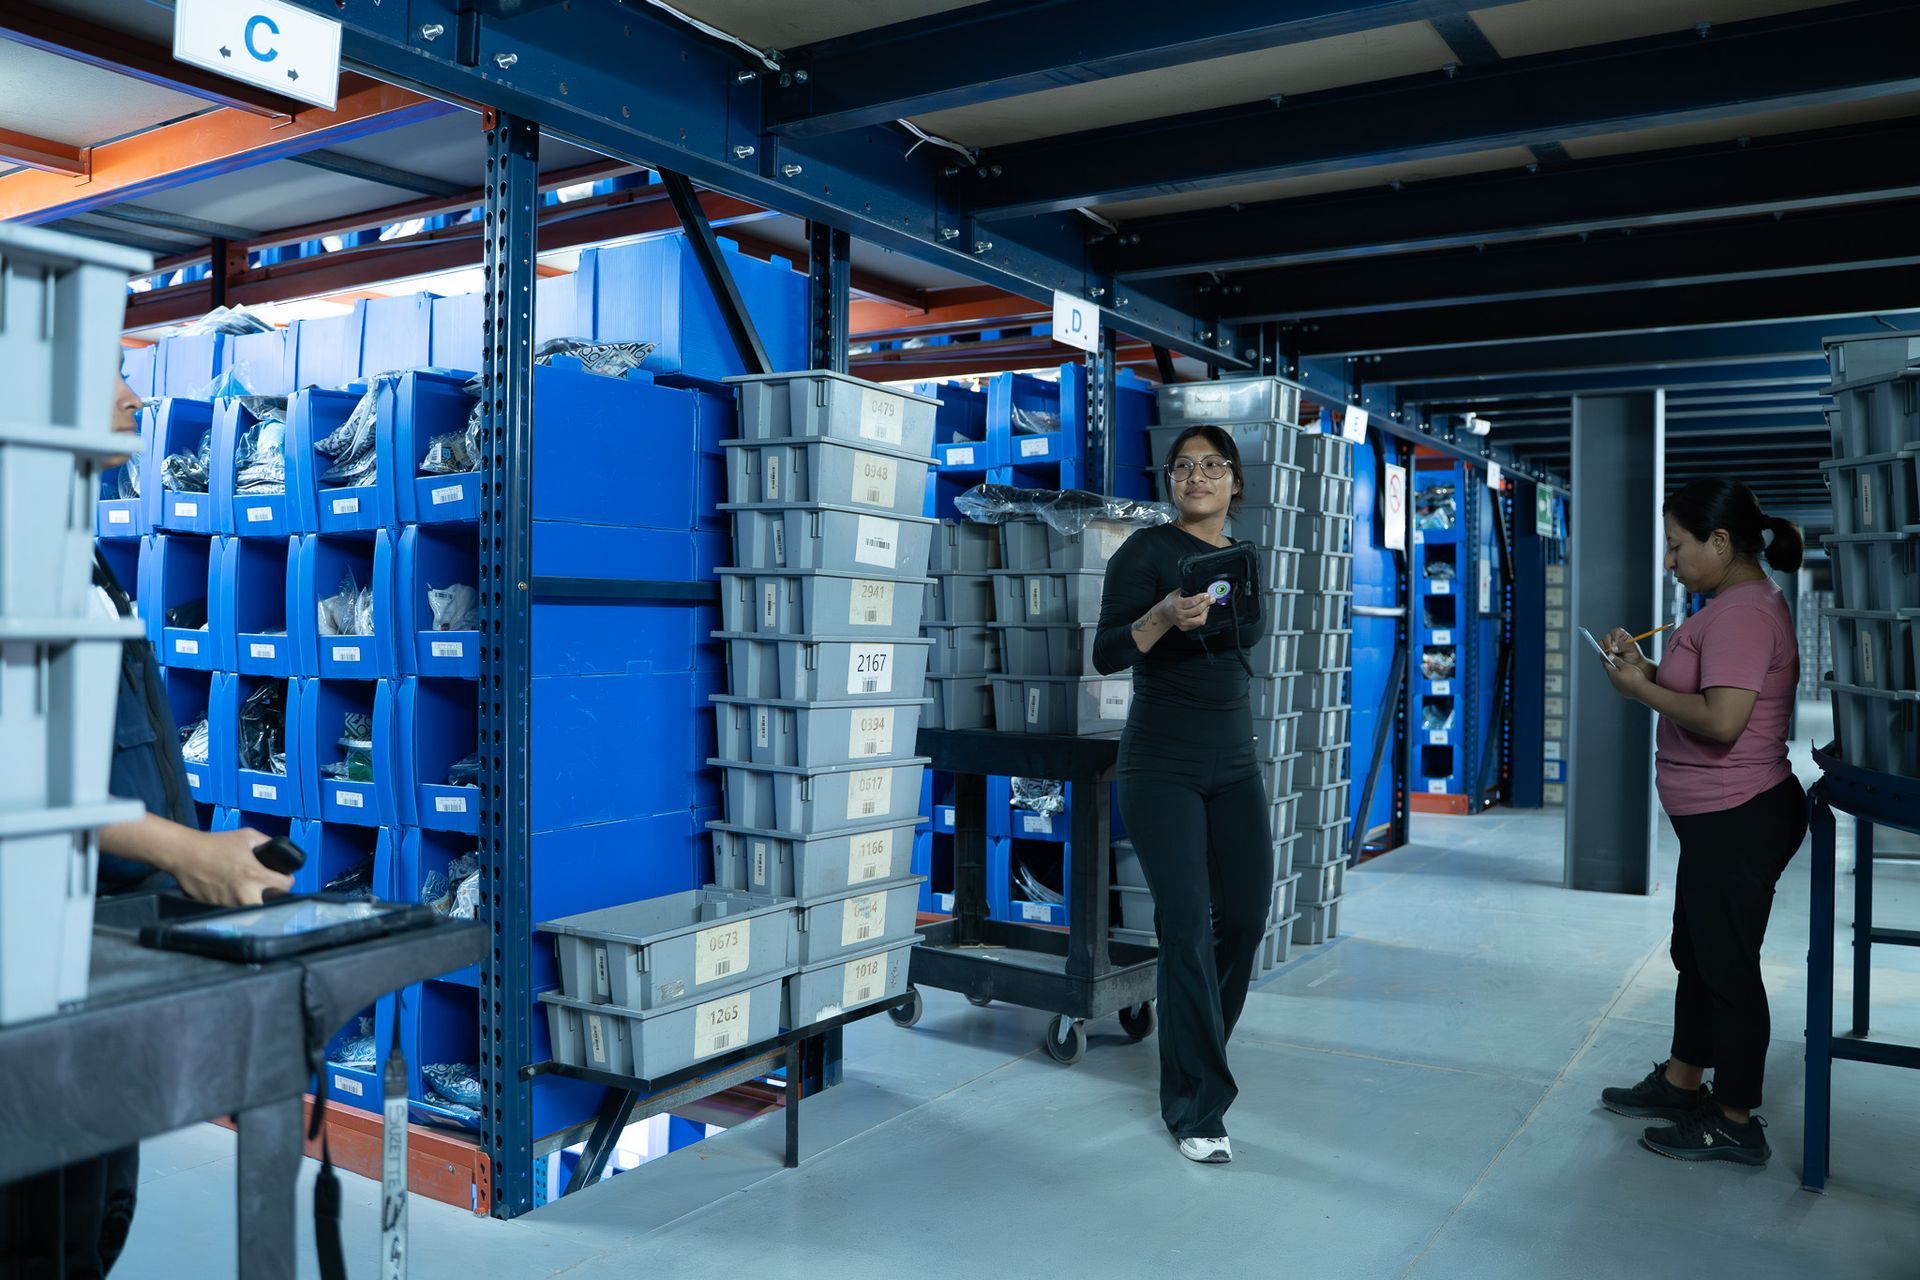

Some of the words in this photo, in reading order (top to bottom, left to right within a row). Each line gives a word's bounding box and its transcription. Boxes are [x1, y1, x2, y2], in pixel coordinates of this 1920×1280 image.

[245, 15, 280, 62] C
[1072, 308, 1082, 332] D
[872, 400, 895, 417] 0479
[864, 463, 888, 481] 0948
[861, 584, 884, 599] 2941
[857, 654, 887, 672] 2167
[861, 716, 885, 731] 0394
[860, 776, 883, 792] 0617
[860, 840, 884, 857] 1166
[710, 931, 738, 952] 0673
[855, 960, 879, 979] 1018
[710, 1004, 738, 1025] 1265
[388, 1105, 405, 1189] SUZETTE
